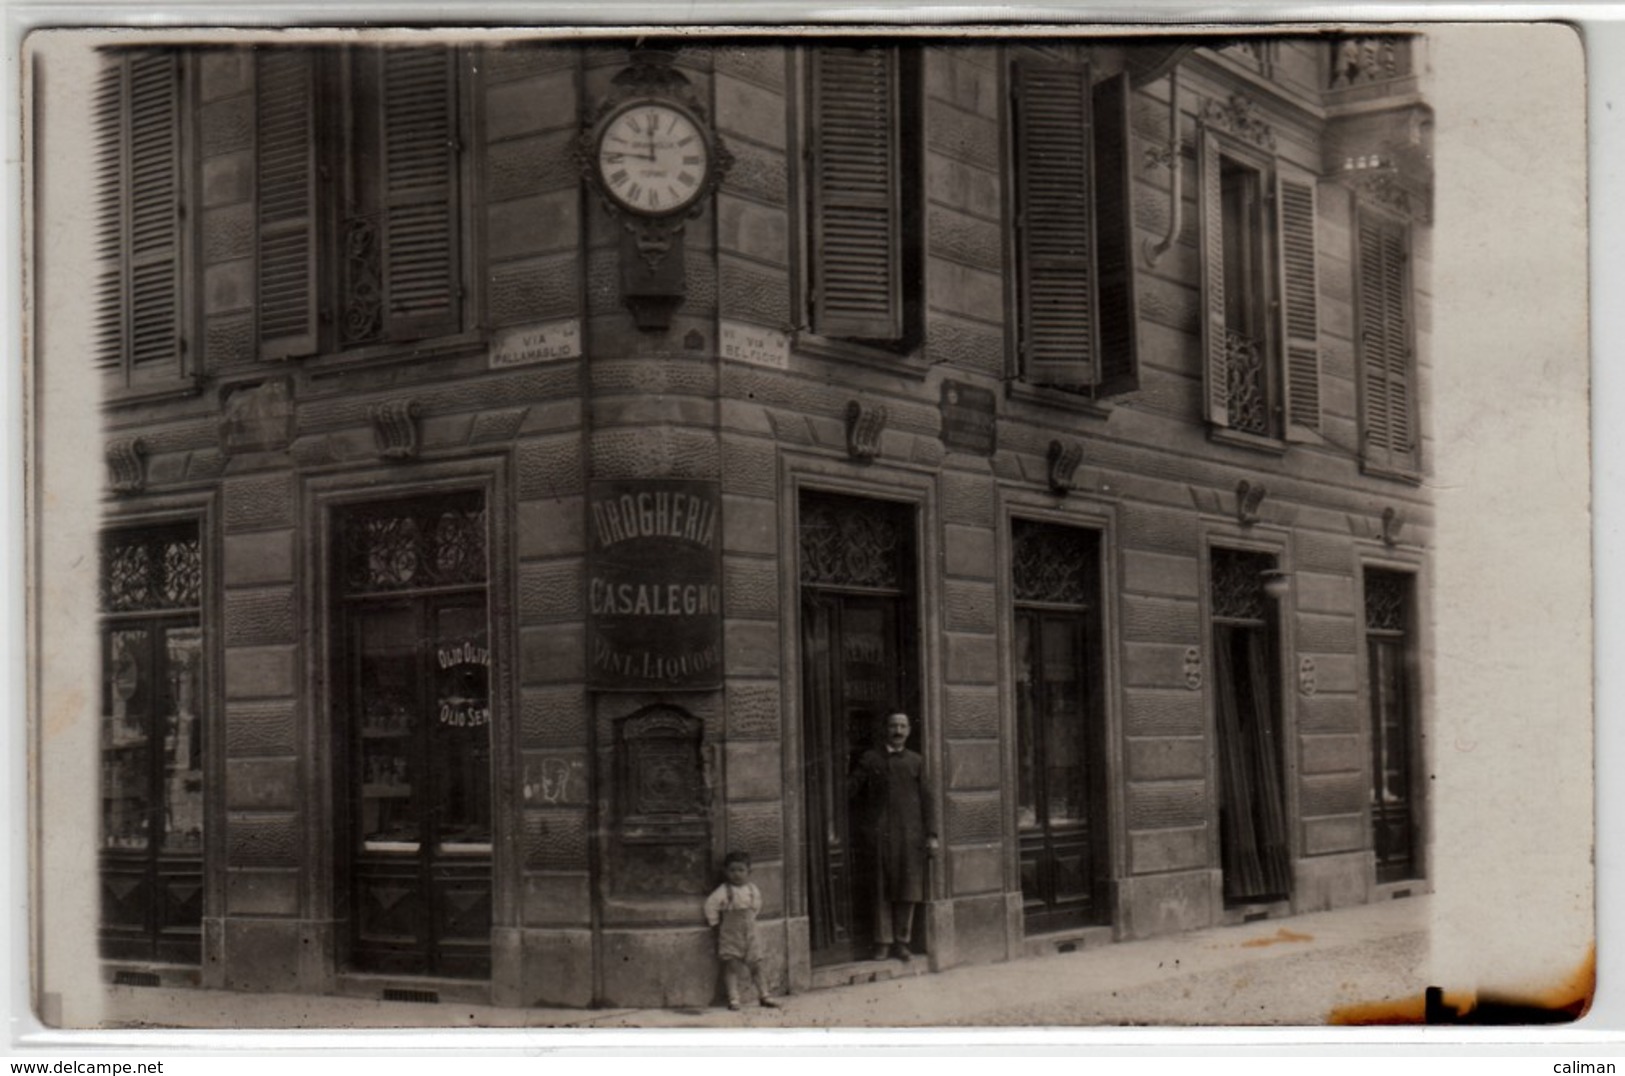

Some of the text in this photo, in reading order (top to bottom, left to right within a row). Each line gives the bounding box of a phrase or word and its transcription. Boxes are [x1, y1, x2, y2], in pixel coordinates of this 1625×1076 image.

[523, 333, 546, 347] VIA
[591, 491, 717, 548] DROGHERIA
[590, 577, 720, 615] CASALEGNO
[438, 647, 463, 669] OLIO
[440, 704, 466, 727] OLIO
